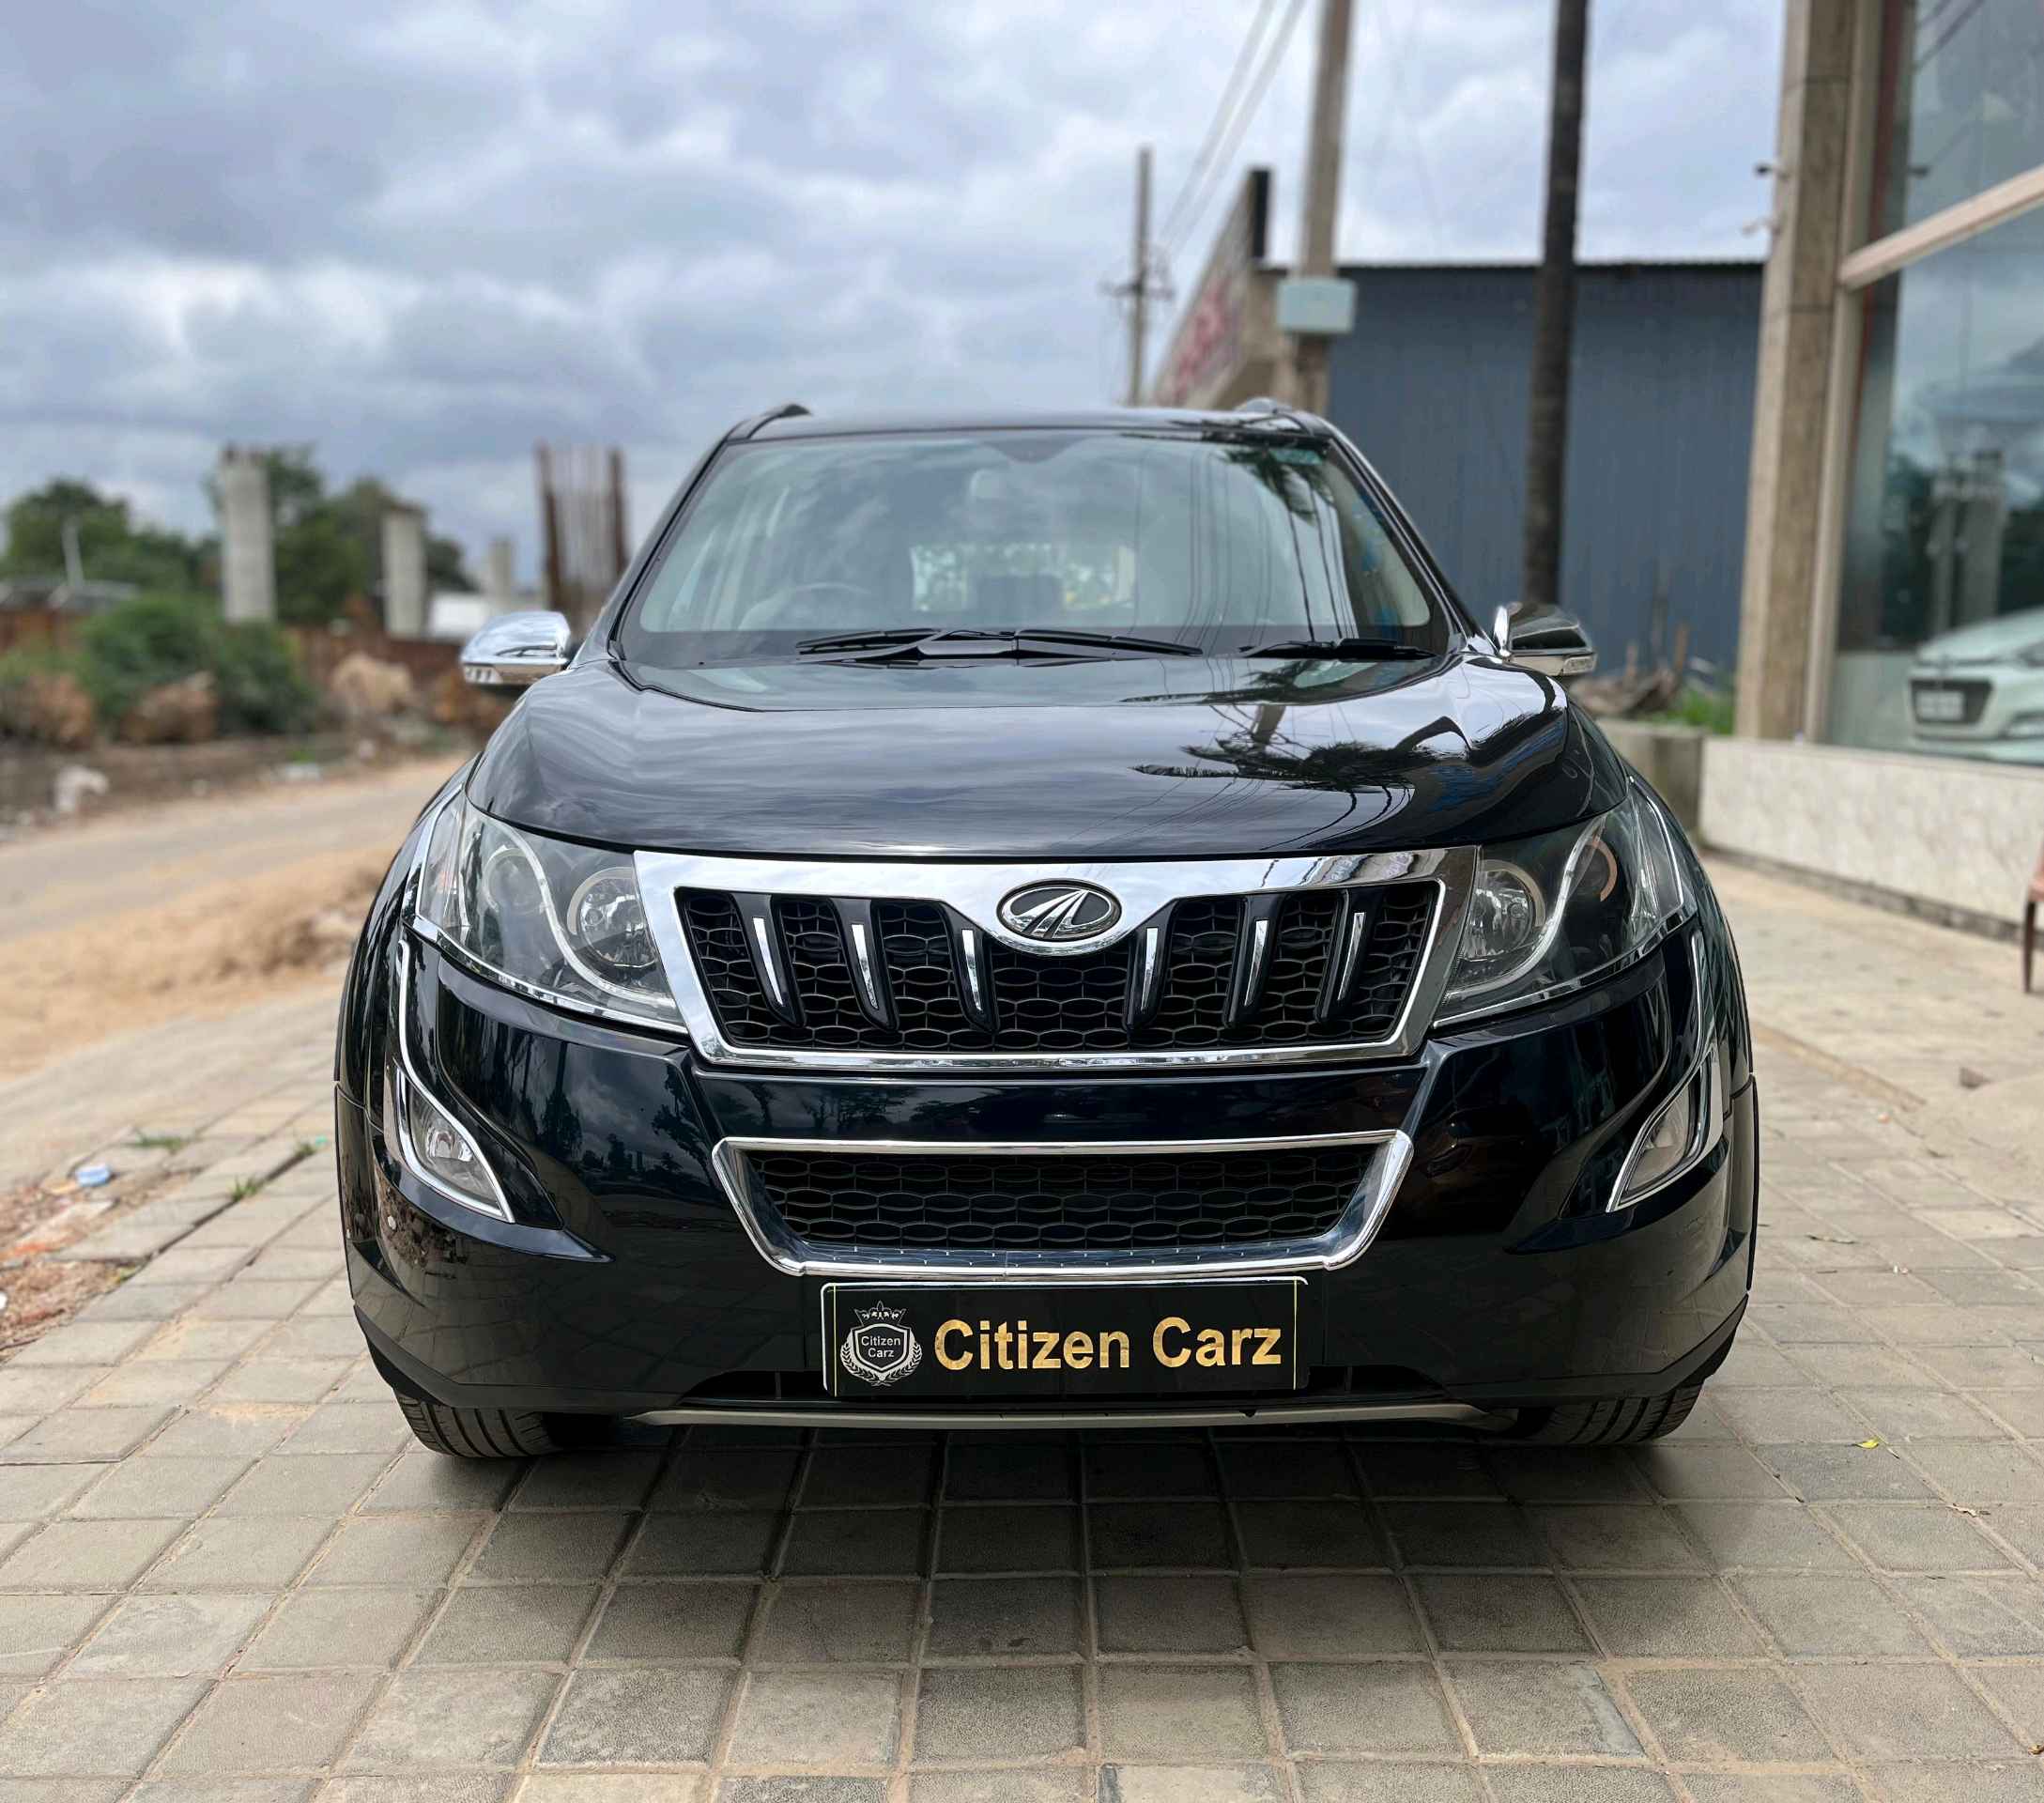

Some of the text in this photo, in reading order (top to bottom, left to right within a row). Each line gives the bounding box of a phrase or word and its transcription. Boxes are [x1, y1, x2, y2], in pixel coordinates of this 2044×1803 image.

[861, 1335, 901, 1347] Citizen
[934, 1316, 1282, 1371] Citizen Carz
[868, 1347, 895, 1358] Carz
